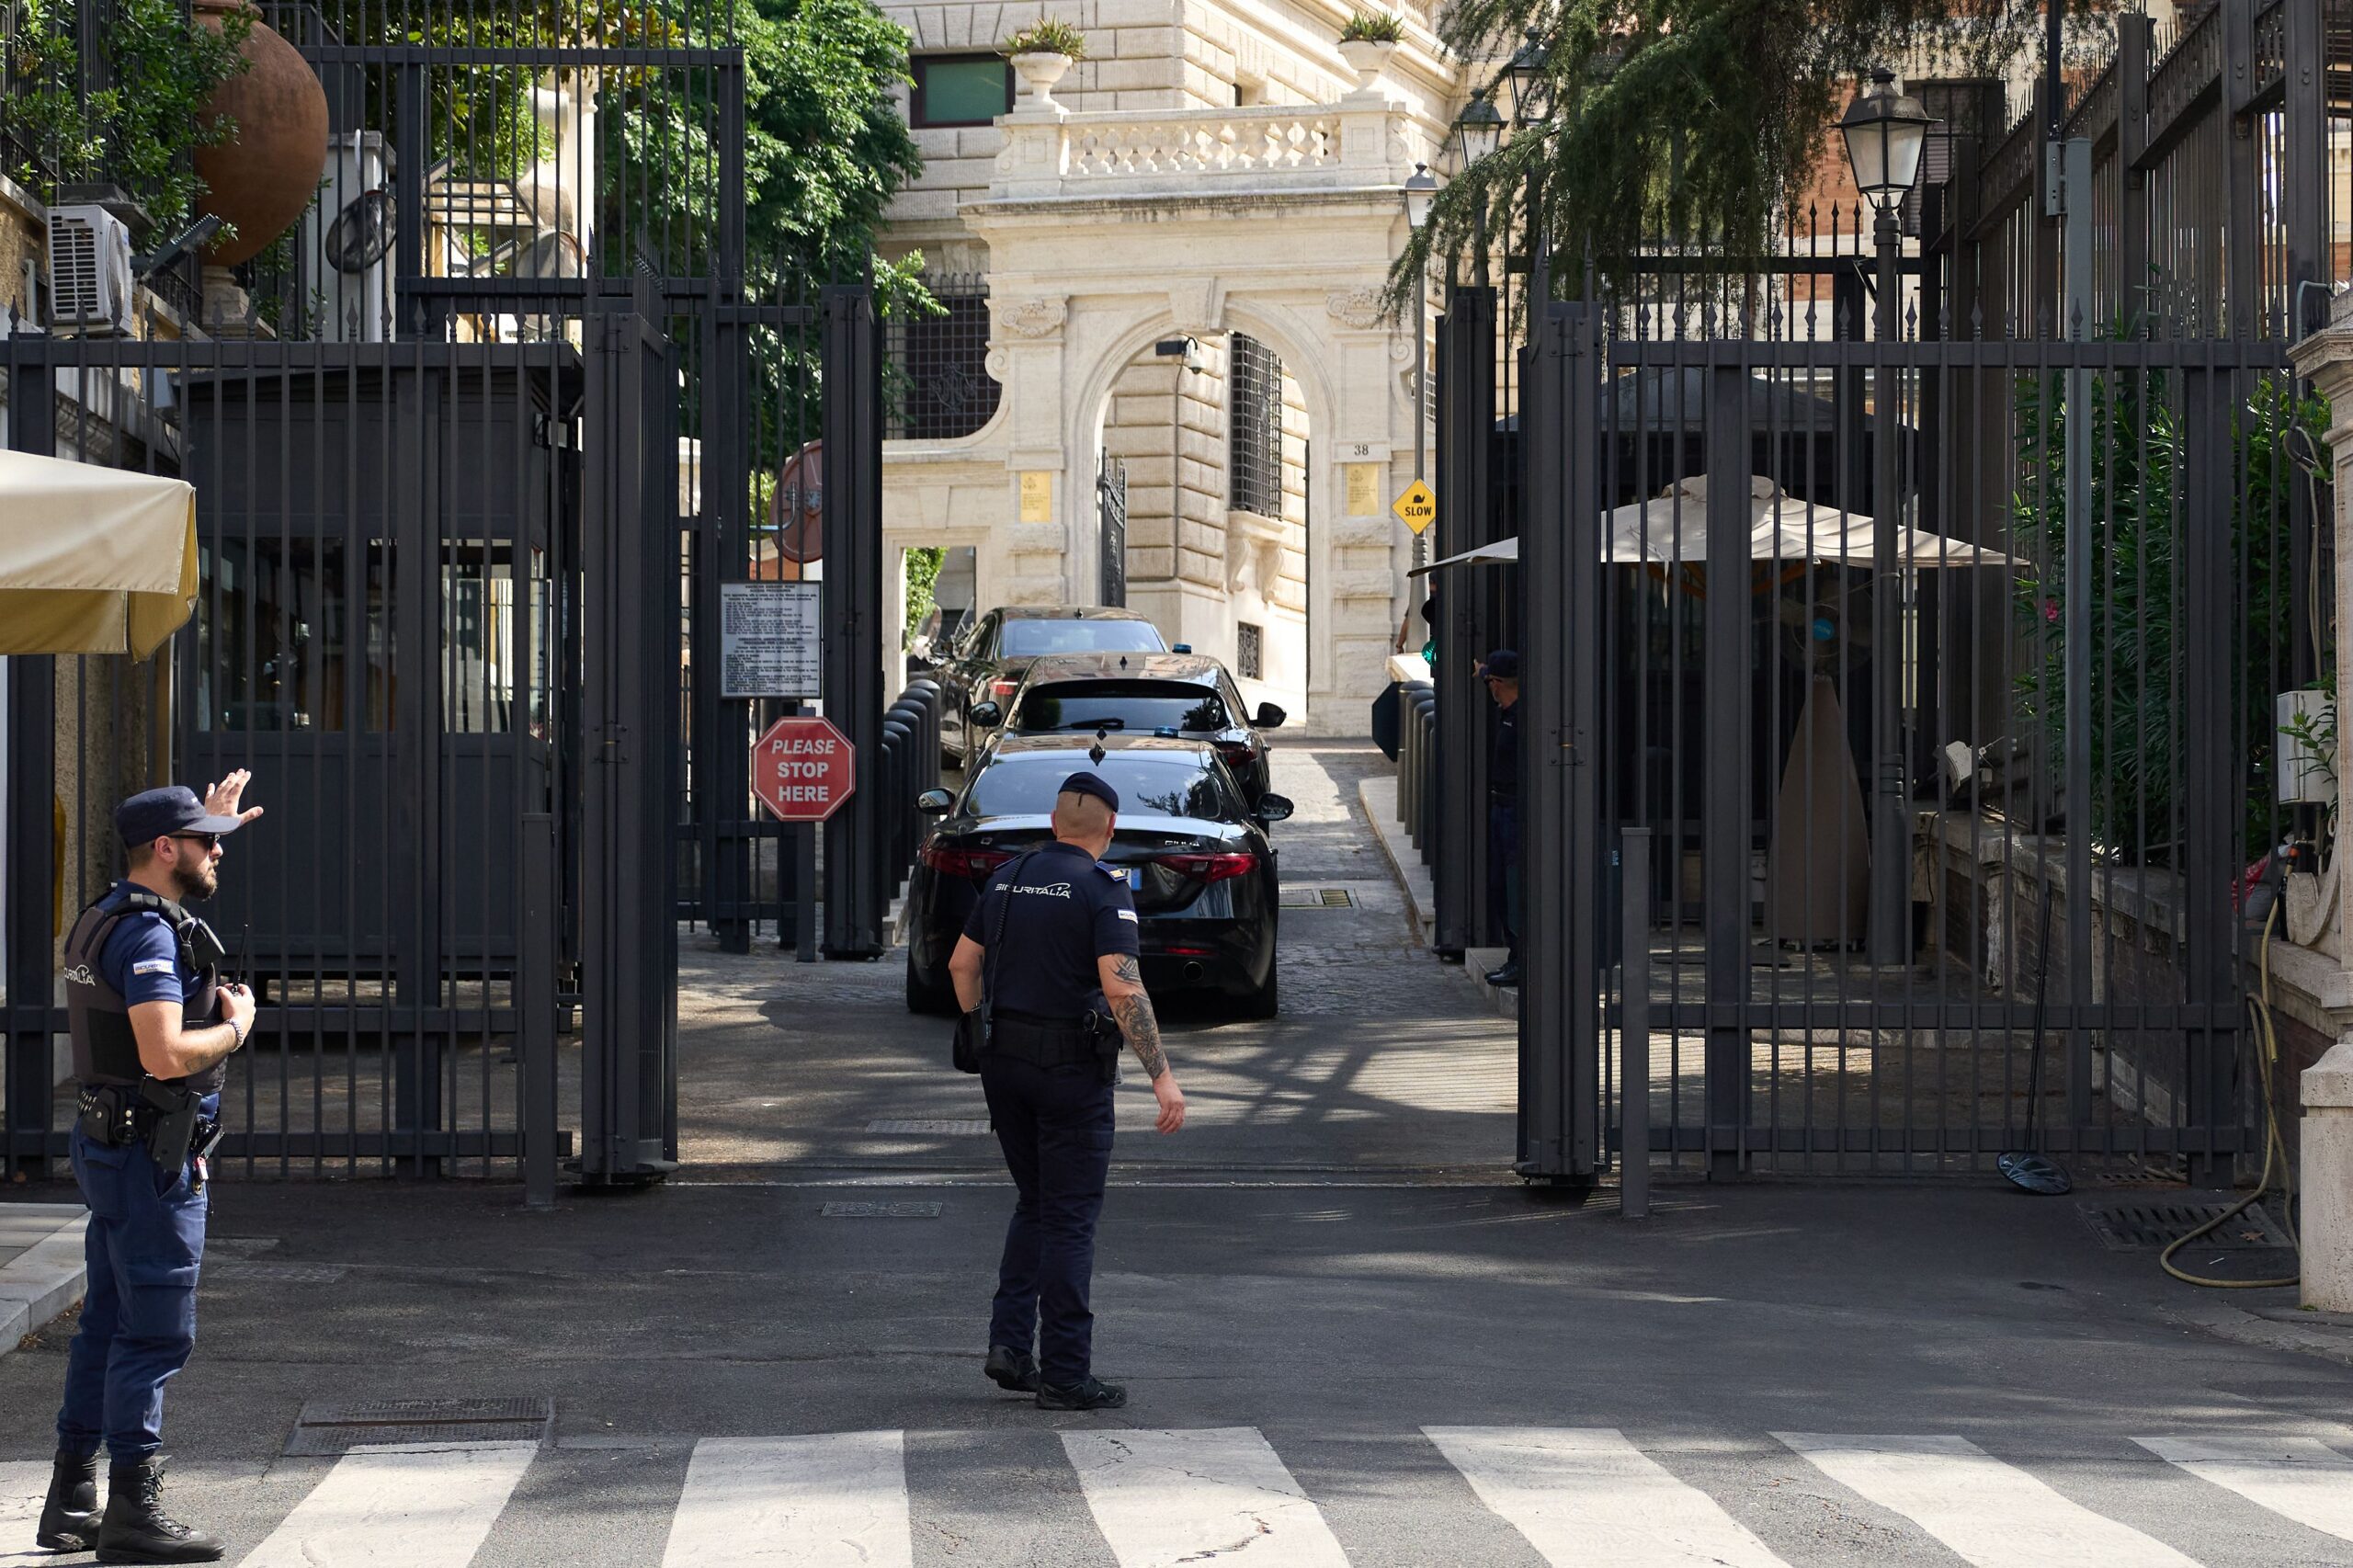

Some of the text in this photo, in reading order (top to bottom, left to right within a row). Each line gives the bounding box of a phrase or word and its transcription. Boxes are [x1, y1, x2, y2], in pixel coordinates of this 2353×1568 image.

[1354, 445, 1369, 456] 38
[1404, 506, 1432, 517] SLOW
[771, 739, 835, 755] PLEASE
[777, 762, 829, 778] STOP
[778, 786, 829, 802] HERE
